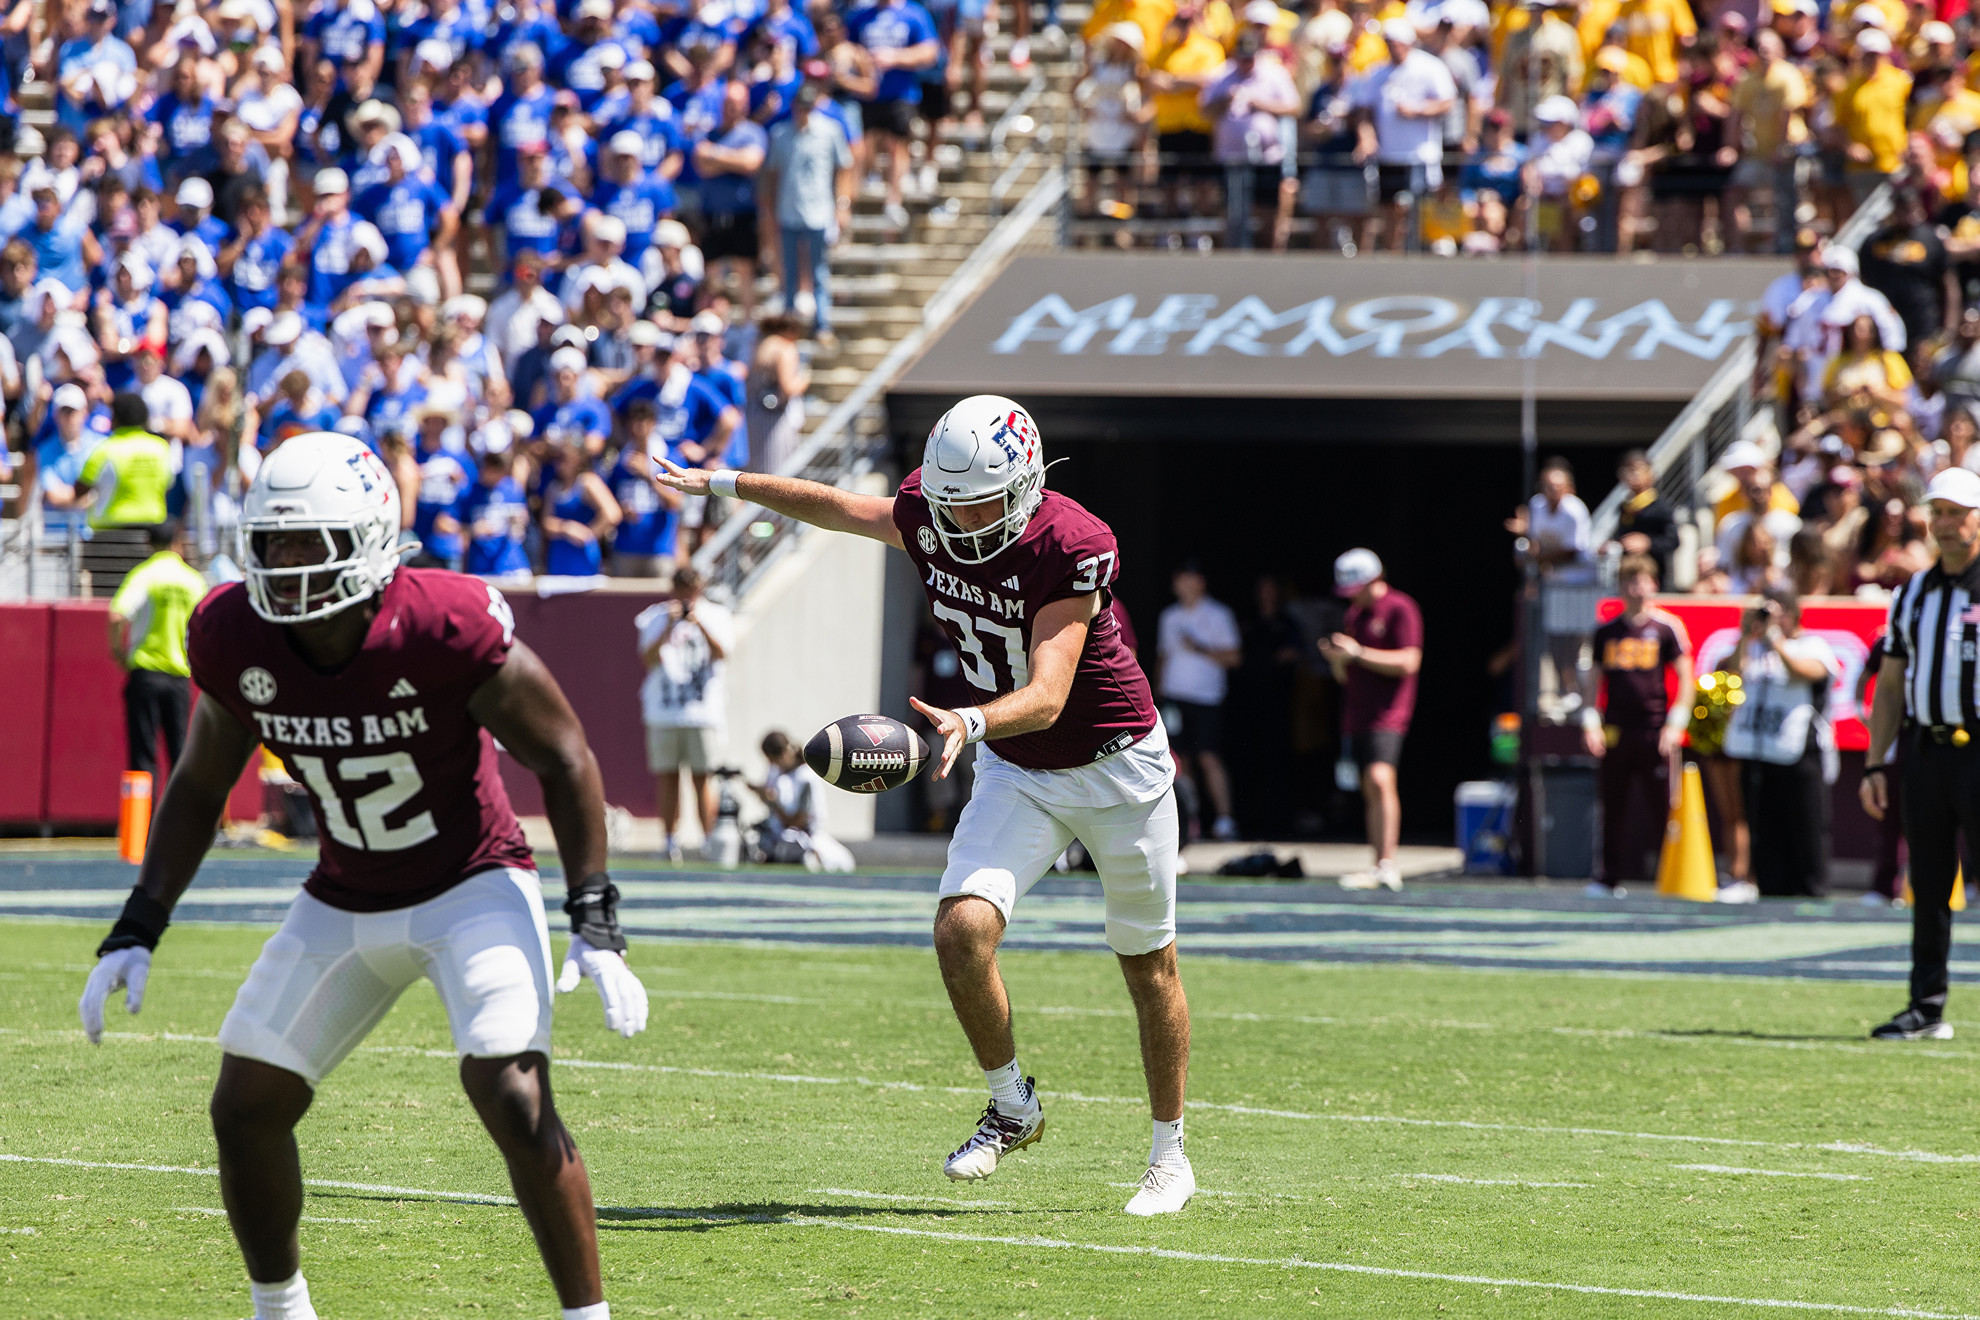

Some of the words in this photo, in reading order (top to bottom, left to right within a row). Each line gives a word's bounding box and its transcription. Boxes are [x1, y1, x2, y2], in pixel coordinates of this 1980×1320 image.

[1009, 292, 1758, 334] MEMORIAL
[990, 316, 1753, 360] HERMANN
[918, 527, 938, 553] SEC
[926, 561, 984, 606] TEXAS
[988, 590, 1025, 620] AM
[1072, 550, 1115, 591] 37
[933, 599, 1030, 693] 37
[240, 667, 276, 704] SEC
[252, 710, 354, 747] TEXAS
[361, 706, 430, 745] A&M
[291, 751, 439, 852] 12
